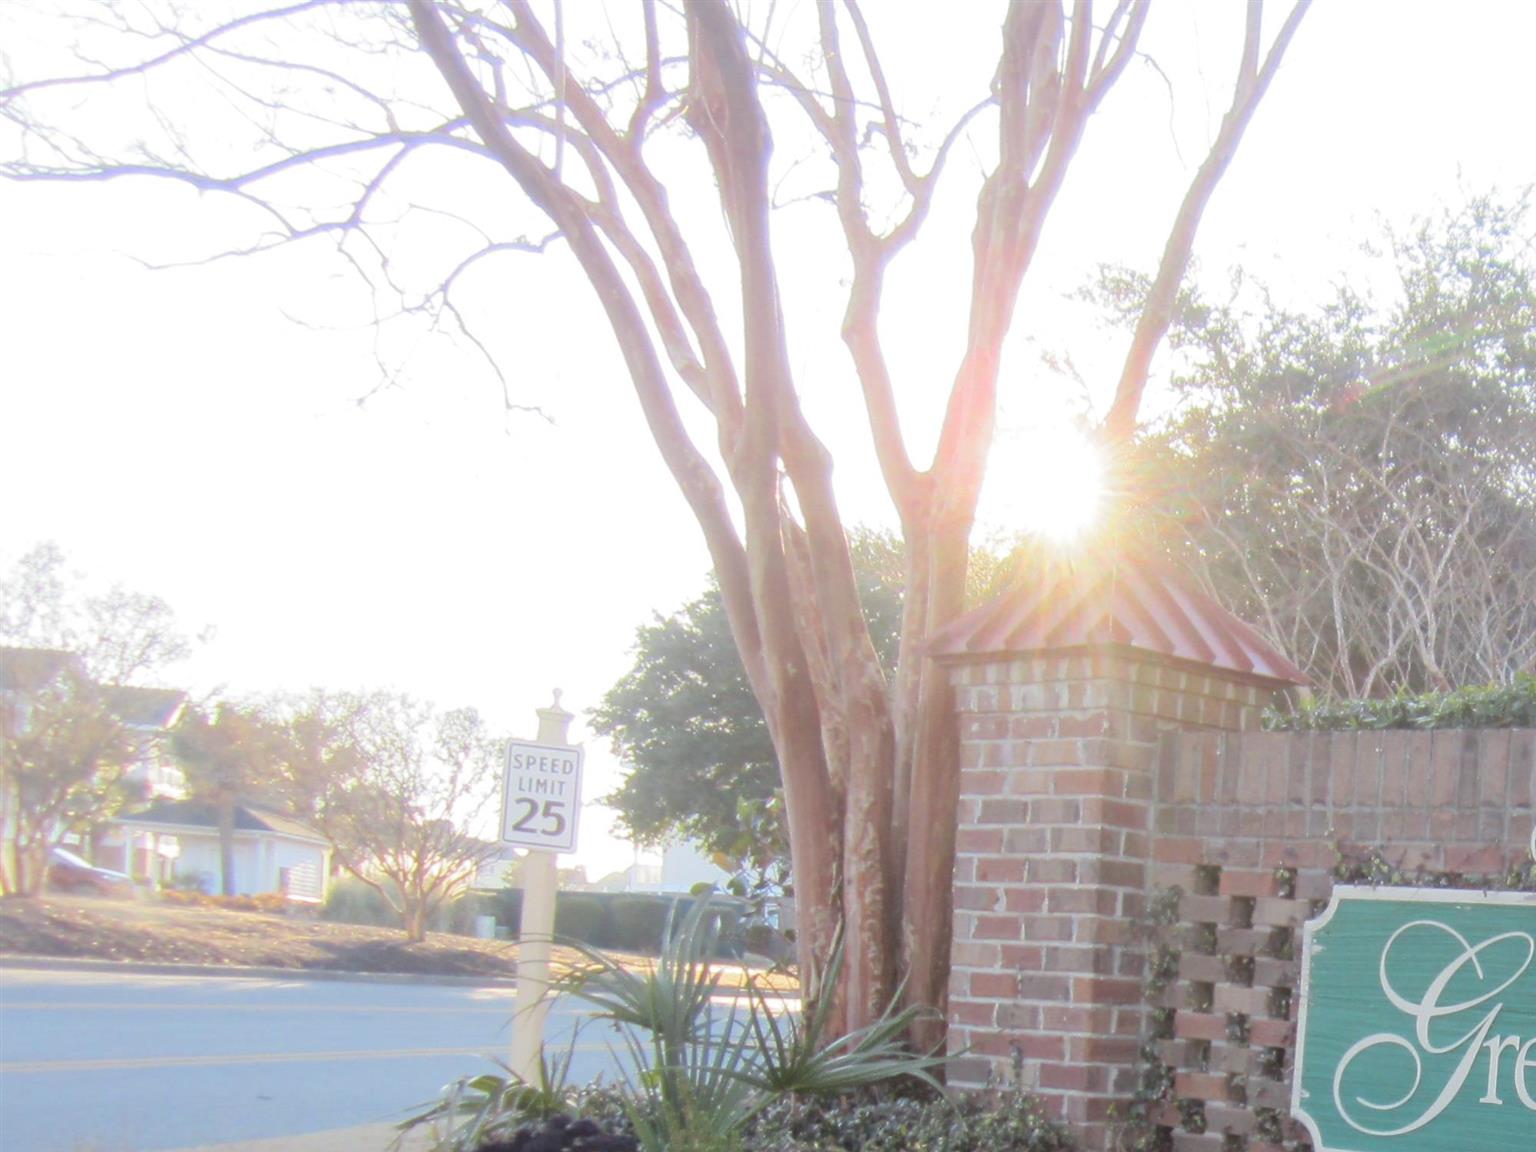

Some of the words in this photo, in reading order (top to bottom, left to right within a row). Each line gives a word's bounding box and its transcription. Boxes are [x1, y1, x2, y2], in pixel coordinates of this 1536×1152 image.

[513, 754, 574, 775] SPEED
[518, 777, 566, 796] LIMIT
[512, 797, 566, 837] 25
